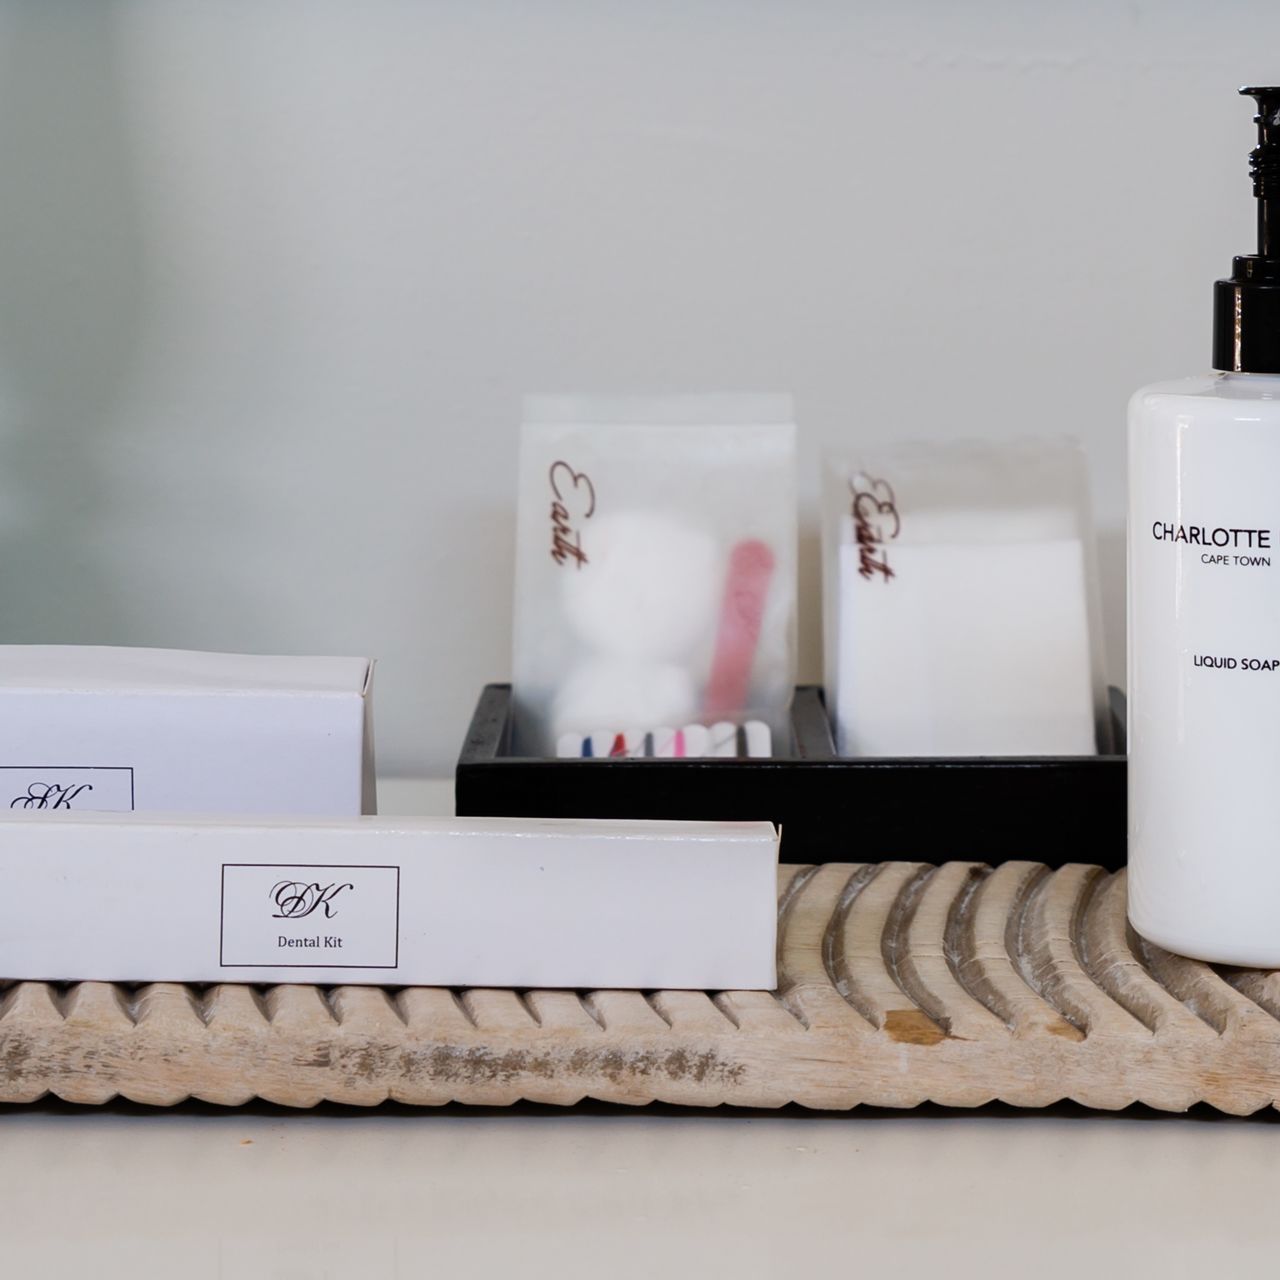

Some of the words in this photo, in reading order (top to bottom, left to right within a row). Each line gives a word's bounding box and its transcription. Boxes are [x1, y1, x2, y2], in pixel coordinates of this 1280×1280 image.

[549, 460, 596, 570] Earth
[1152, 521, 1271, 549] CHARLOTTE
[1200, 553, 1230, 566] CAPE
[1233, 555, 1271, 567] TOWN
[1193, 654, 1237, 669] LIQUID
[1240, 658, 1280, 671] SOAP
[277, 935, 320, 948] Dental
[323, 936, 343, 948] Kit
